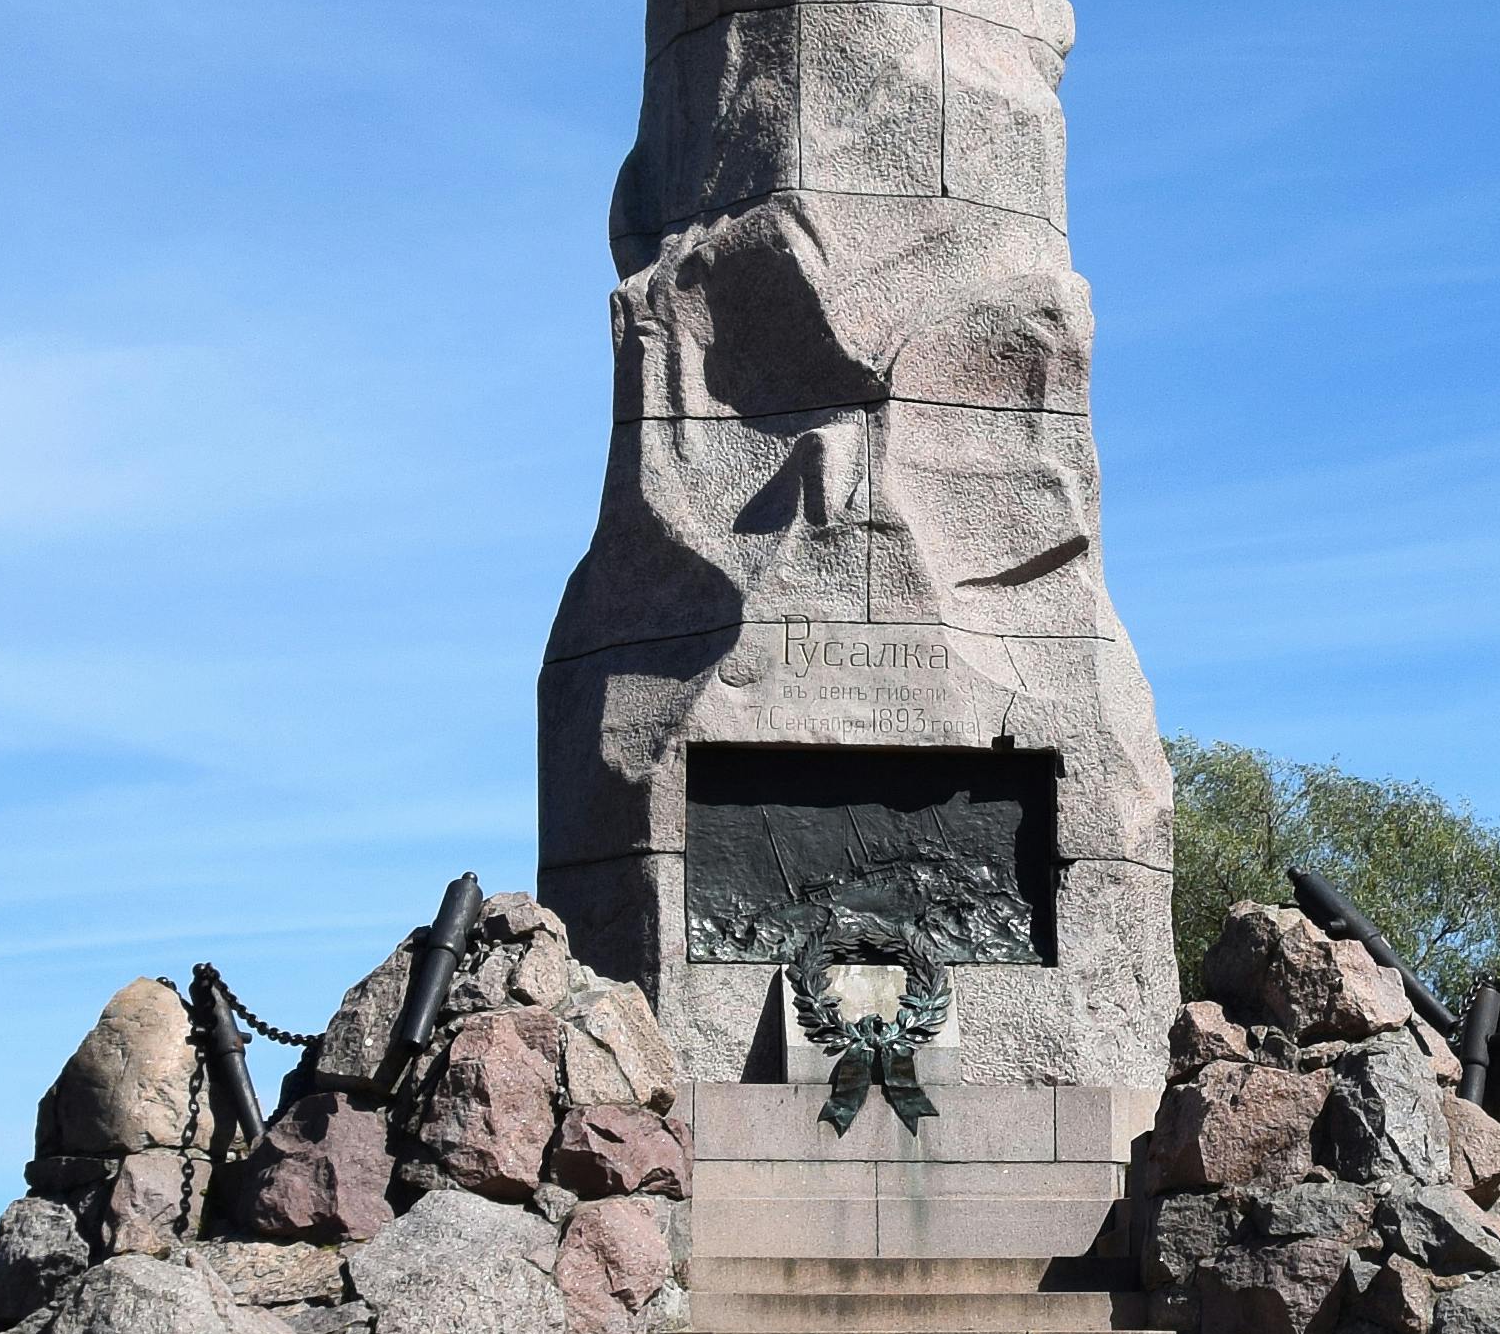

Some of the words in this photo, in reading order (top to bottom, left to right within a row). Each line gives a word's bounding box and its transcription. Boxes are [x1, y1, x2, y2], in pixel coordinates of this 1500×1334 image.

[780, 614, 950, 678] Русалка
[783, 685, 808, 699] въ
[875, 686, 947, 702] гибели
[872, 708, 927, 734] 1893
